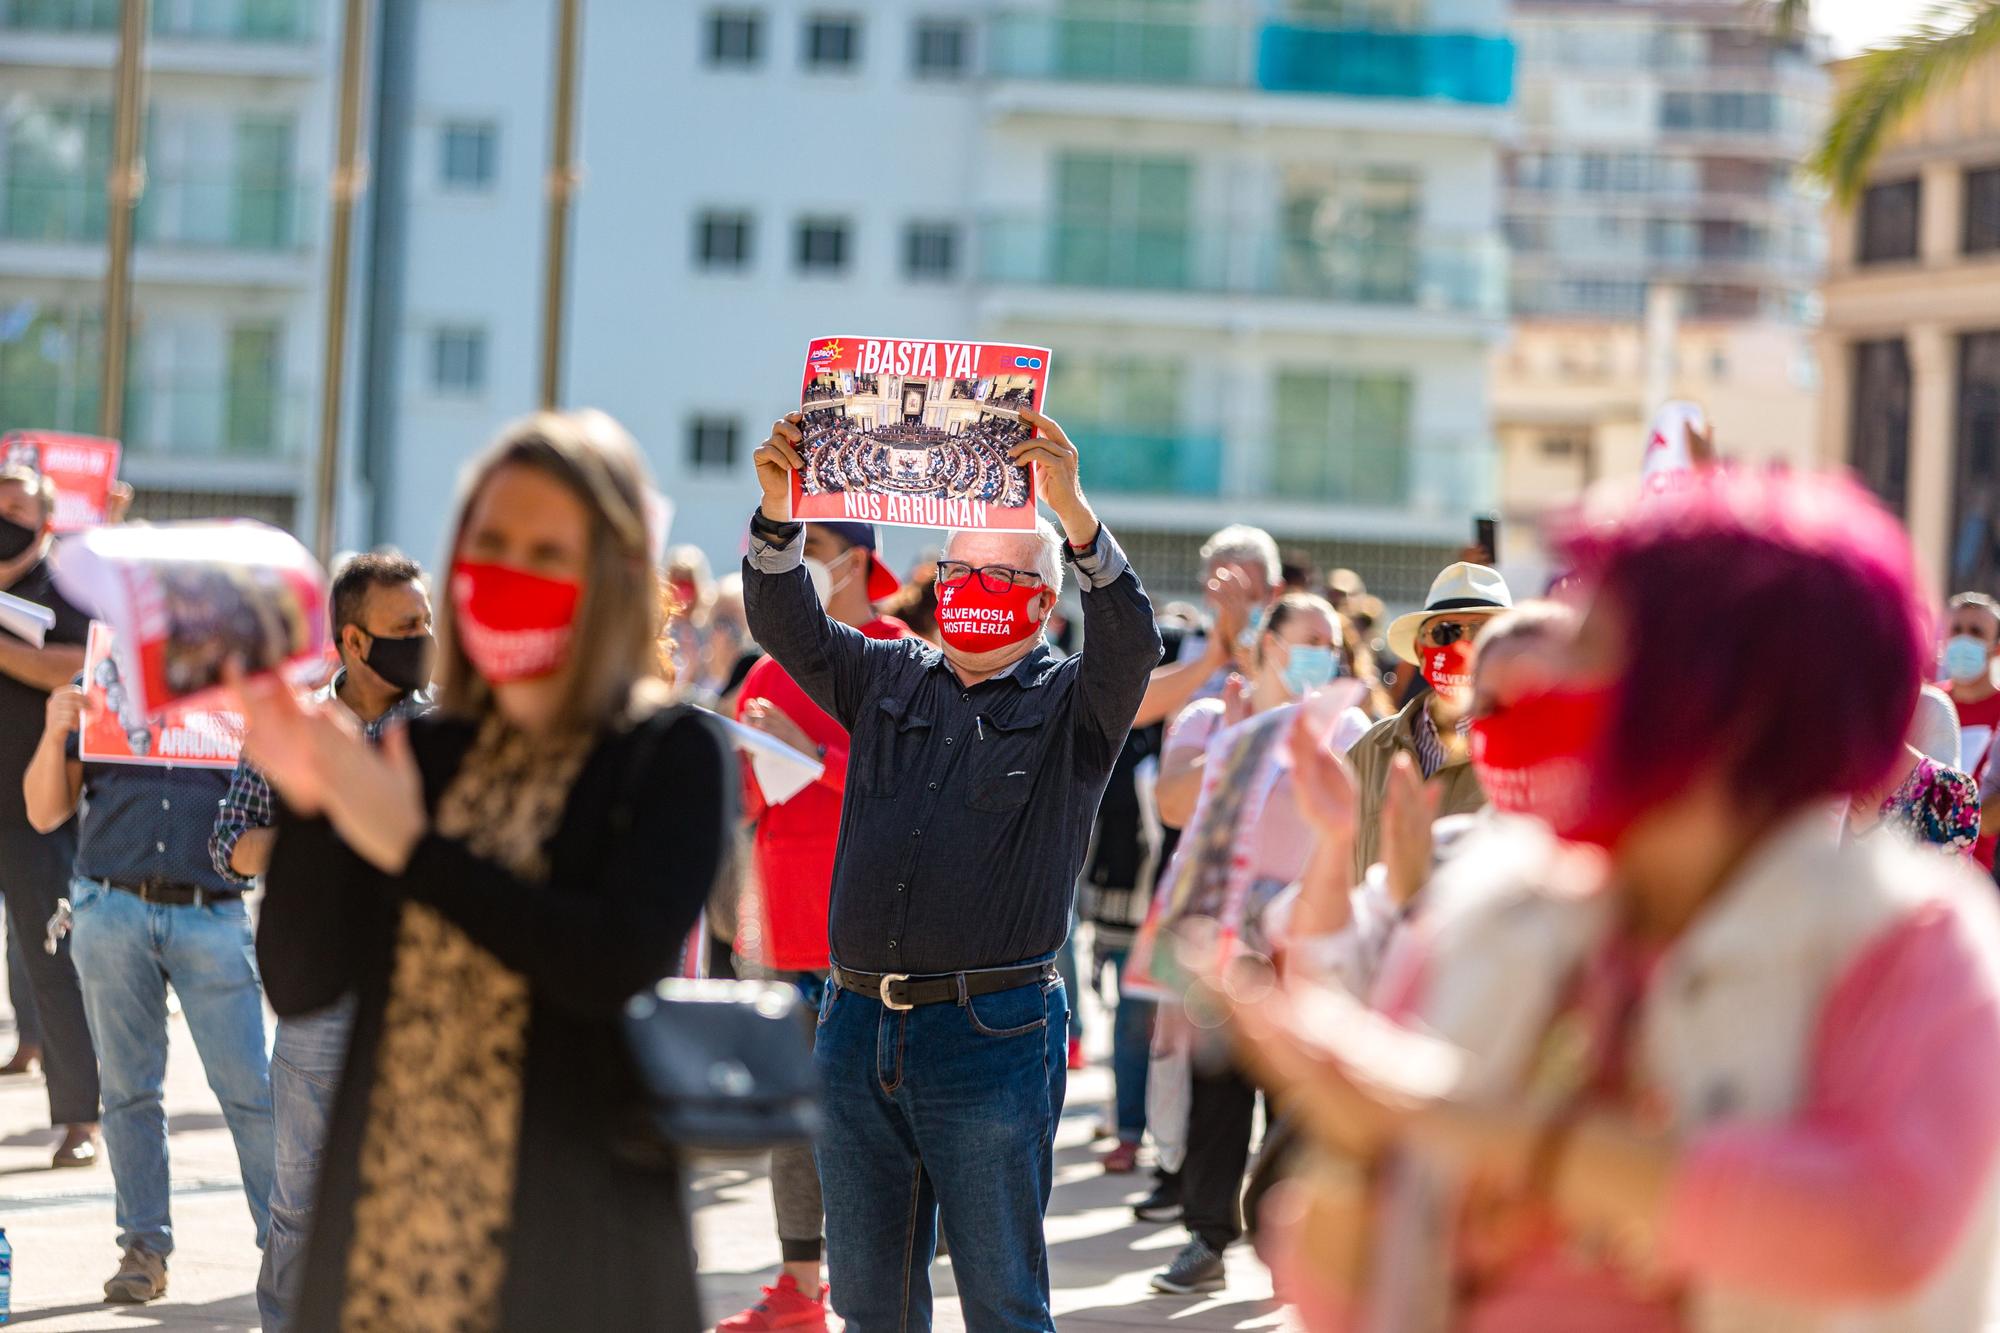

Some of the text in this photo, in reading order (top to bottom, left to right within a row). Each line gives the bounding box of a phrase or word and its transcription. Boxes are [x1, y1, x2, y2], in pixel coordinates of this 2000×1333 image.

[855, 340, 982, 379] ¡BASTA YA!
[843, 491, 987, 528] NOS ARRUINAN
[942, 587, 955, 606] #
[941, 607, 1015, 622] SALVEMOSLA
[943, 621, 1011, 635] HOSTELERÍA
